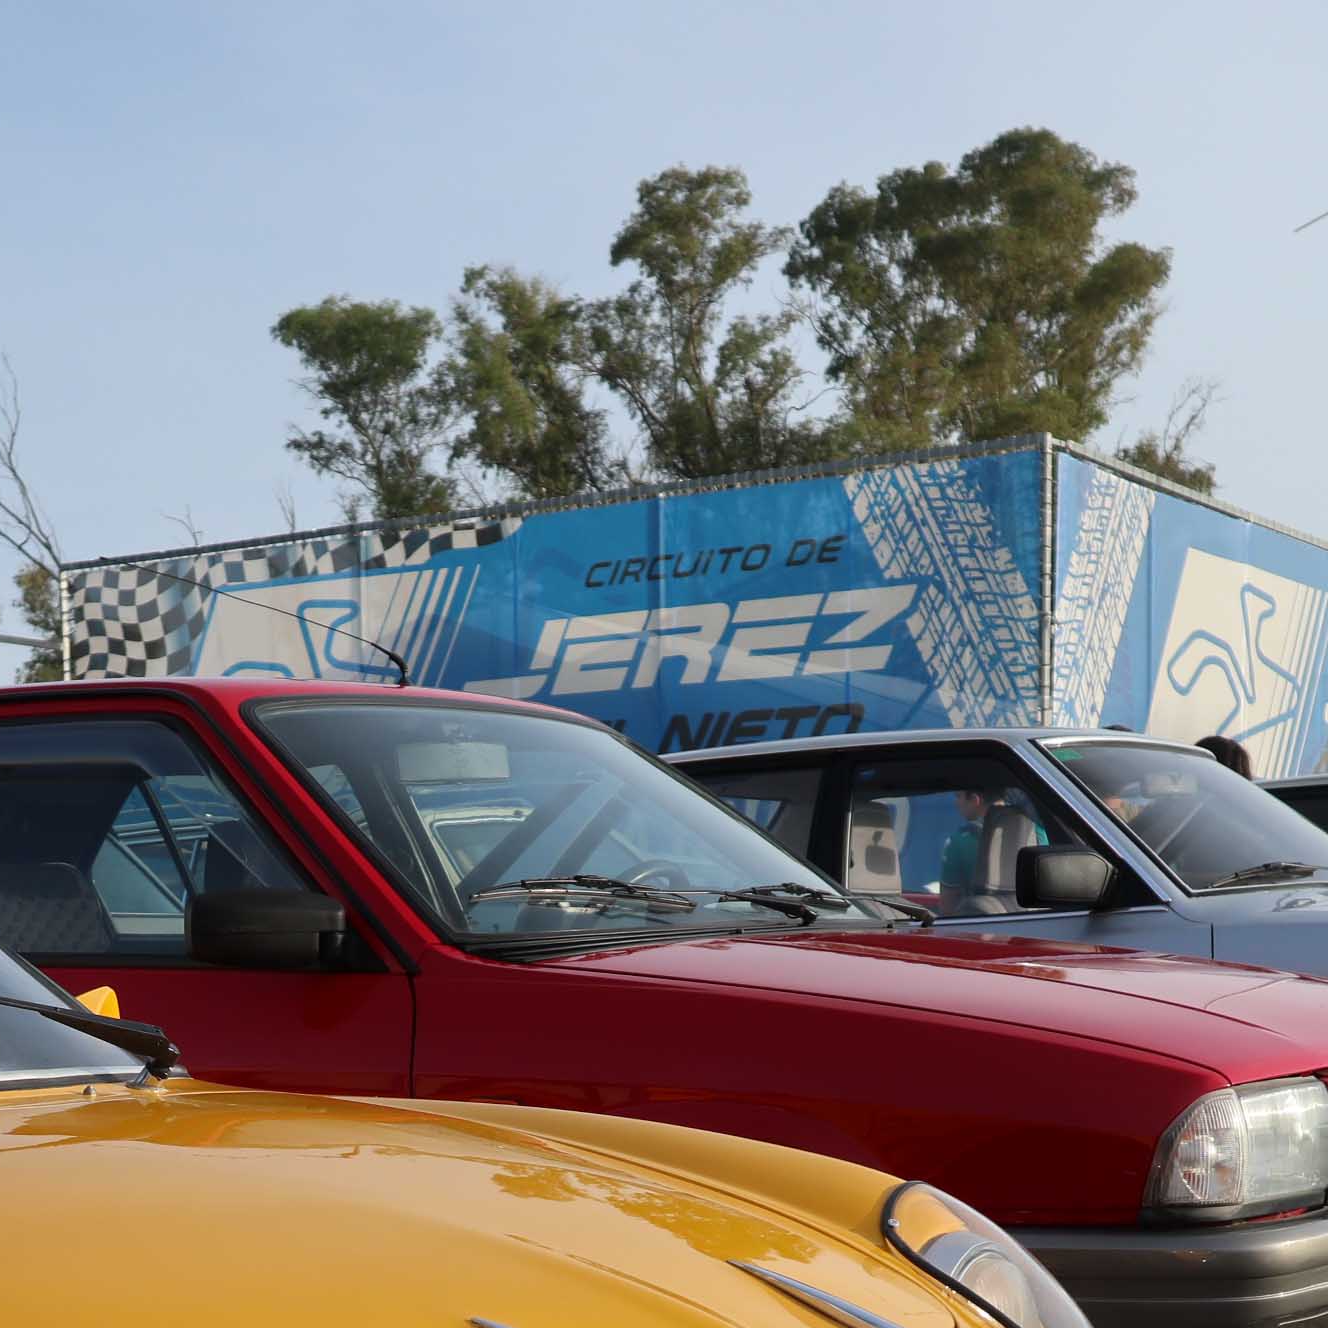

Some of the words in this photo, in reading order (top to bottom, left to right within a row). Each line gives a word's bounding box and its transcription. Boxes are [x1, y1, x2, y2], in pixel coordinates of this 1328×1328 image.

[584, 543, 772, 589] CIRCUITO
[785, 534, 847, 567] DE
[463, 583, 919, 700] JEREZ
[658, 702, 865, 754] NIETO
